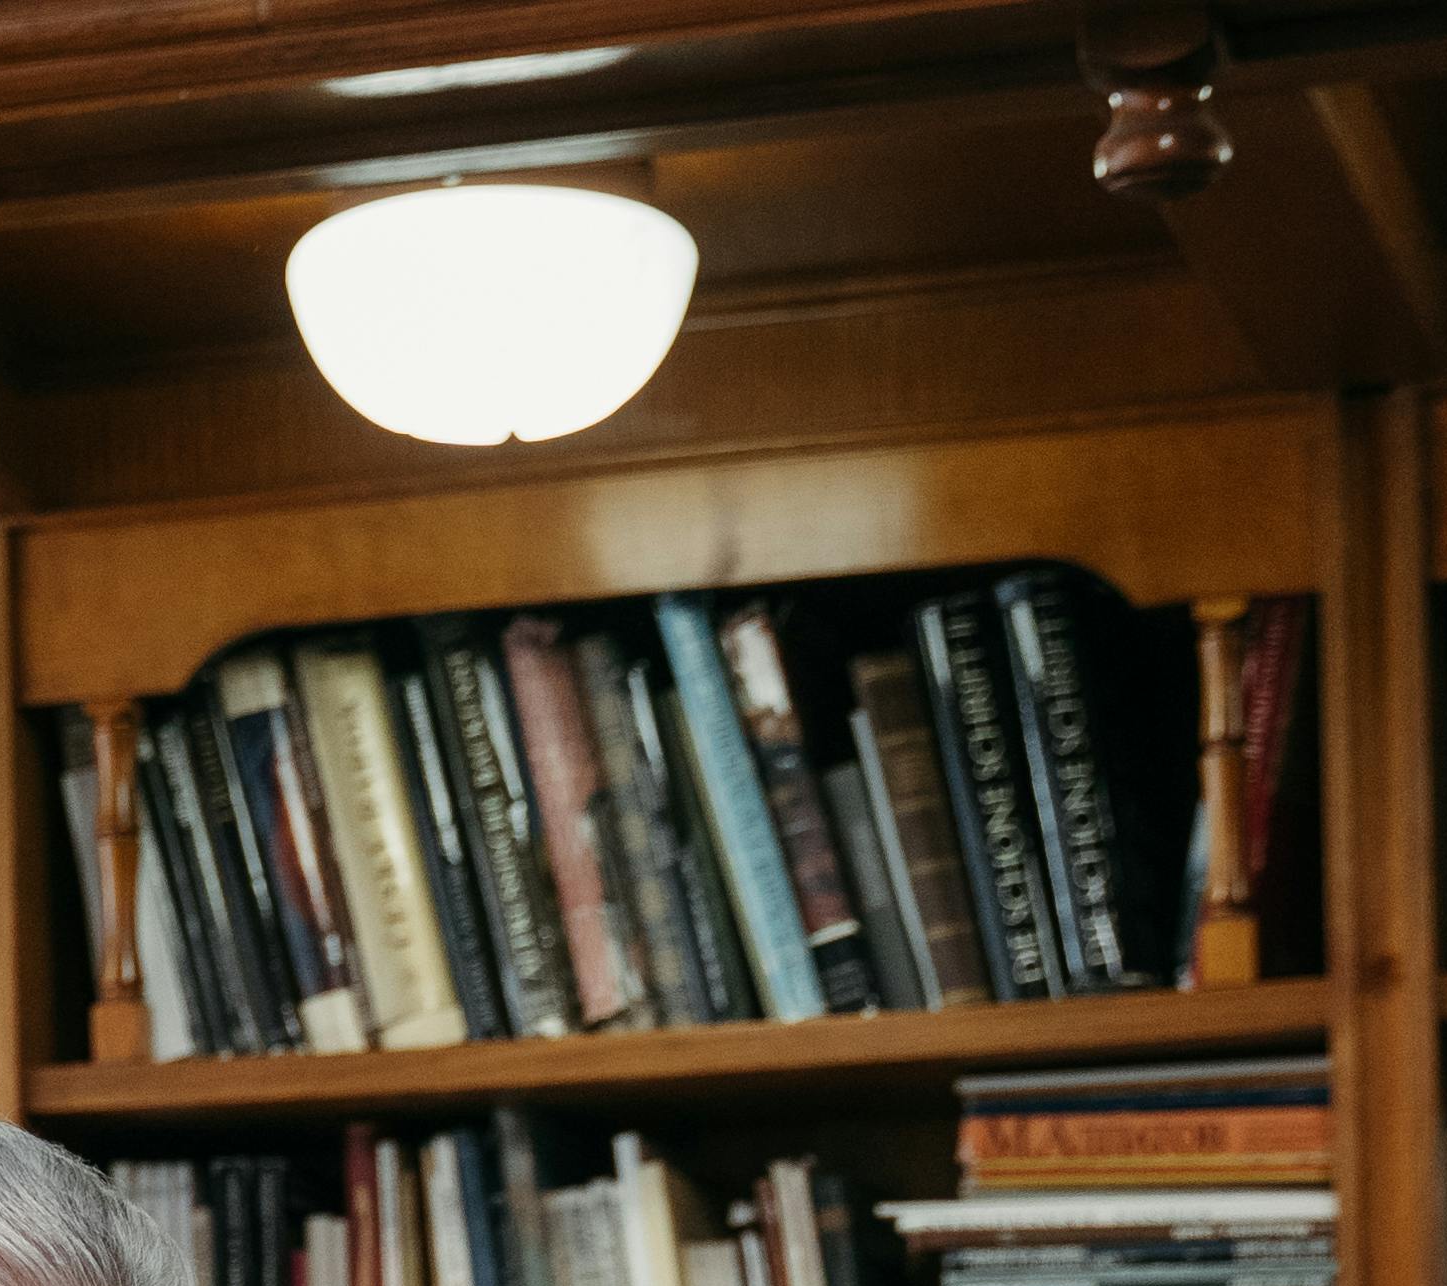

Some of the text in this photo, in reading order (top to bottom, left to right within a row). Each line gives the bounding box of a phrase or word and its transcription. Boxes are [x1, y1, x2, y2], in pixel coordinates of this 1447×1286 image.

[955, 646, 1007, 783] SCHRIFT
[1033, 618, 1089, 756] SCHRIFT
[1004, 932, 1043, 985] DIE
